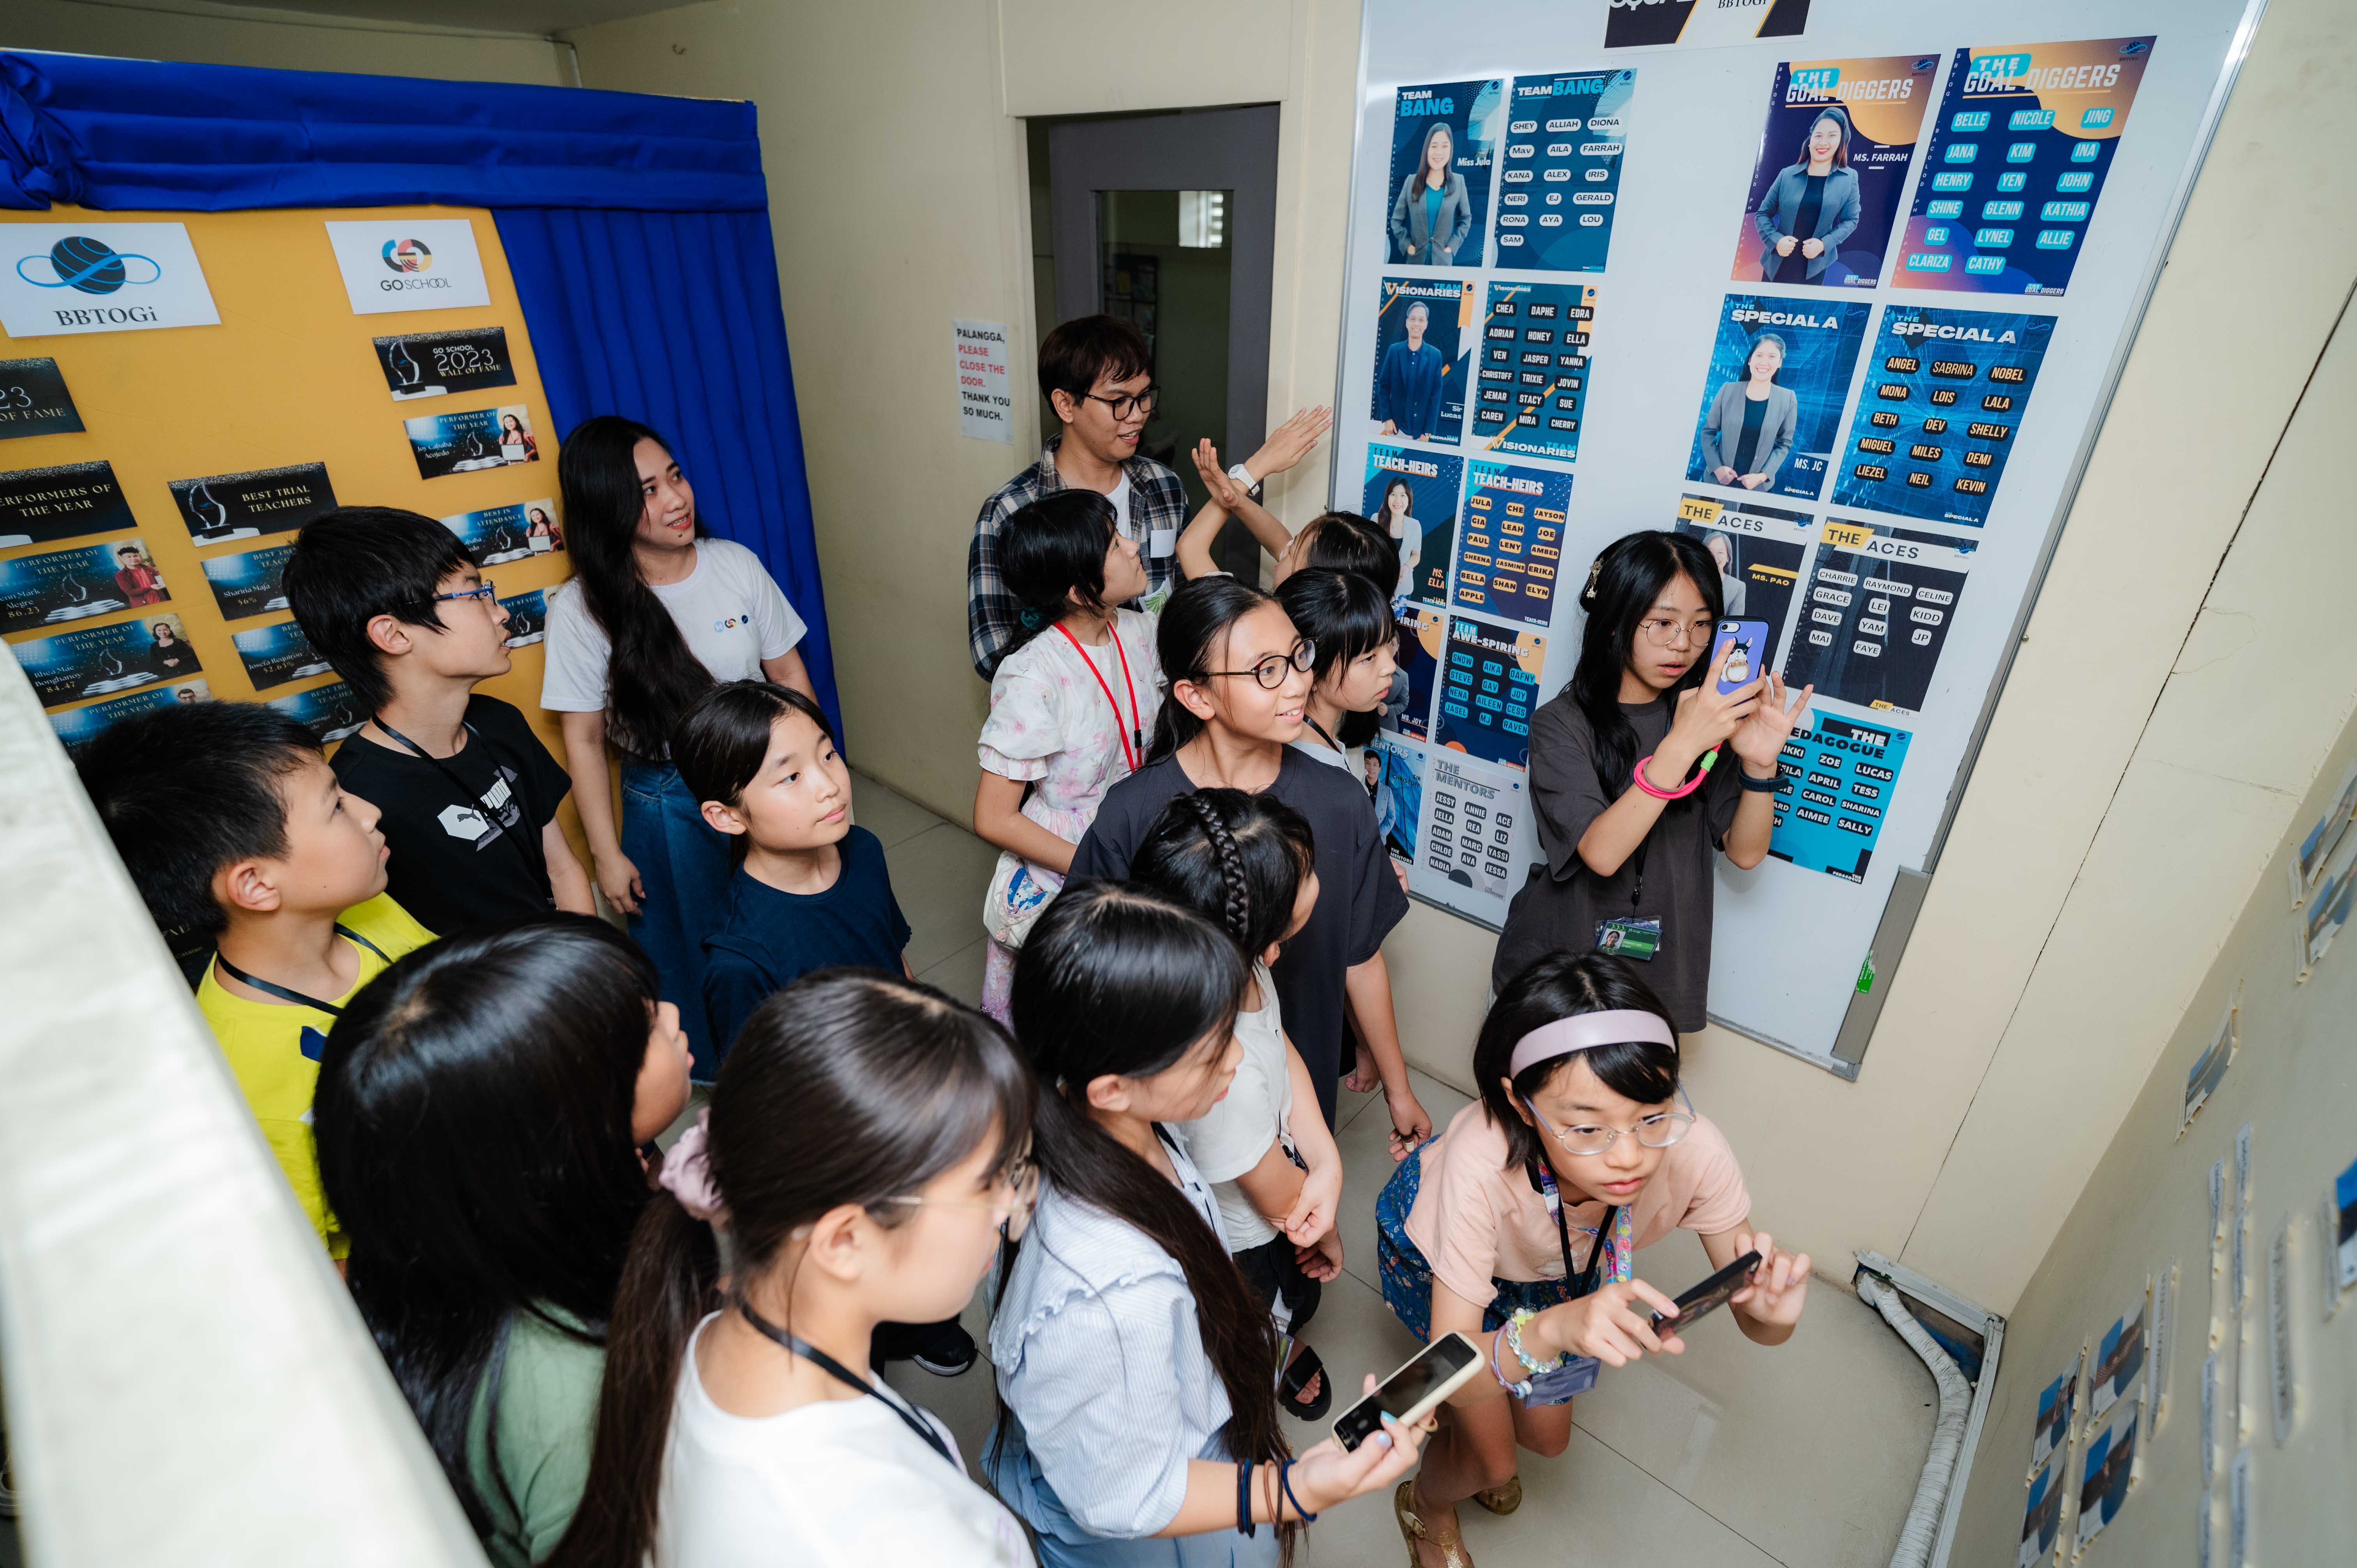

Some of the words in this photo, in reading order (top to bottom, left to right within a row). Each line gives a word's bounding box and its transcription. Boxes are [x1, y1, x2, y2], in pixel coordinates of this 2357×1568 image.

[1979, 58, 2020, 71] THE
[1797, 71, 1830, 83] THE
[1963, 70, 2017, 93] GOAL
[2024, 65, 2120, 90] DIGGERS
[1518, 86, 1552, 96] TEAM
[1552, 78, 1604, 96] BANG
[1786, 83, 1829, 102] GOAL
[1836, 79, 1914, 101] DIGGERS
[1402, 90, 1432, 100] TEAM
[1401, 97, 1454, 116] BANG
[1954, 113, 1988, 127] BELLE
[2012, 111, 2053, 125] NICOLE
[1457, 157, 1474, 166] Miss
[1475, 157, 1490, 166] Jula
[1853, 154, 1869, 162] MS.
[1935, 174, 1971, 186] HENRY
[2060, 174, 2091, 187] JOHN
[1930, 201, 1961, 214] SHINE
[1986, 202, 2021, 215] GLENN
[2045, 203, 2086, 216] KATHIA
[1977, 230, 2009, 243] LYNEL
[2039, 232, 2072, 244] ALLIE
[1909, 255, 1949, 268] CLARIZA
[1968, 257, 2004, 270] CATHY
[1384, 282, 1461, 298] VISIONARIES
[55, 306, 159, 327] BBTOGi
[1531, 306, 1555, 316] DAPHE
[1731, 310, 1820, 328] SPECIAL
[1822, 317, 1838, 329] A
[957, 328, 1005, 344] PALANGGA,
[1489, 328, 1514, 338] ADRIAN
[1528, 331, 1551, 341] HONEY
[1891, 322, 1995, 342] SPECIAL
[1998, 330, 2016, 344] A
[958, 344, 989, 357] PLEASE
[435, 349, 493, 371] 2023
[1523, 354, 1548, 364] JASPER
[1561, 357, 1583, 366] YANNA
[1887, 357, 1916, 370] ANGEL
[439, 369, 463, 377] WALL
[480, 364, 502, 373] FAME
[960, 360, 986, 372] CLOSE
[988, 364, 1005, 374] THE
[1933, 362, 1973, 376] SABRINA
[1991, 367, 2023, 380] NOBEL
[961, 376, 986, 387] DOOR.
[1482, 370, 1512, 380] CHRISTOFF
[1484, 391, 1507, 401] JEMAR
[1880, 385, 1906, 397] MONA
[962, 391, 989, 404] THANK
[993, 396, 1010, 407] YOU
[1520, 394, 1542, 404] STACY
[23, 408, 66, 419] FAME
[439, 413, 484, 423] PERFORMER
[963, 406, 974, 416] SO
[976, 409, 1003, 421] MUCH.
[1551, 419, 1576, 429] CHERRY
[1970, 424, 2008, 437] SHELLY
[1490, 436, 1576, 458] VISIONARIES
[1546, 441, 1576, 451] TEAM
[1861, 438, 1891, 452] MIGUEL
[1912, 445, 1940, 458] MILES
[1375, 447, 1398, 457] TEAM
[1966, 452, 1991, 465] DEMI
[1373, 455, 1438, 476] TEACH-HEIRS
[1475, 465, 1500, 475] TEAM
[1794, 458, 1809, 470] MS.
[1812, 460, 1823, 471] JC
[1857, 465, 1884, 479] LIEZEL
[1474, 472, 1543, 494] TEACH-HEIRS
[1956, 479, 1986, 493] KEVIN
[0, 487, 87, 506] ERFORMERS
[92, 484, 111, 494] OF
[242, 490, 272, 502] BEST
[276, 485, 310, 496] TRIAL
[19, 506, 50, 517] THE
[54, 500, 94, 512] YEAR
[248, 497, 311, 512] TEACHERS
[1534, 510, 1564, 520] JAYSON
[1684, 505, 1713, 520] THE
[1718, 516, 1763, 532] ACES
[1944, 514, 1972, 522] SPECIAL
[1828, 529, 1861, 545] THE
[1866, 541, 1919, 559] ACES
[1532, 547, 1558, 556] AMBER
[1465, 554, 1490, 563] SHEENA
[1496, 561, 1525, 570] JASMINE
[1528, 566, 1553, 576] ERIKA
[1432, 568, 1443, 579] MS.
[1752, 574, 1768, 582] MS.
[1770, 576, 1790, 586] PAO
[1820, 572, 1856, 583] CHARRIE
[1428, 577, 1444, 590] ELLA
[1866, 581, 1910, 593] RAYMOND
[237, 597, 257, 606] 56%
[1459, 591, 1484, 600] APPLE
[1816, 591, 1849, 603] GRACE
[1919, 591, 1951, 602] CELINE
[8, 606, 40, 618] 86.23
[1815, 612, 1839, 622] DAVE
[1913, 611, 1940, 622] KIDD
[1455, 622, 1477, 636] TEAM
[1452, 631, 1528, 657] AWE-SPIRING
[1856, 644, 1878, 654] FAYE
[263, 662, 294, 674] 52.63%
[1451, 671, 1472, 683] STEVE
[1510, 670, 1535, 683] DAFNY
[47, 681, 76, 693] 84.47
[1477, 696, 1501, 710] AILEEN
[1891, 707, 1910, 716] ACES
[1504, 721, 1527, 734] RAVEN
[1792, 727, 1885, 759] EDAGOGUE
[1851, 729, 1886, 746] THE
[1438, 759, 1459, 774] THE
[1856, 765, 1892, 780] LUCAS
[1436, 775, 1494, 800] MENTORS
[1809, 774, 1839, 788] APRIL
[1803, 791, 1834, 805] CAROL
[1465, 805, 1486, 818] ANNIE
[1841, 801, 1879, 817] SHARINA
[1797, 809, 1829, 824] AIMEE
[1838, 819, 1872, 834] SALLY
[1431, 843, 1452, 856] CHLOE
[1462, 838, 1481, 851] MARC
[1833, 871, 1862, 883] PEDAGOGUE
